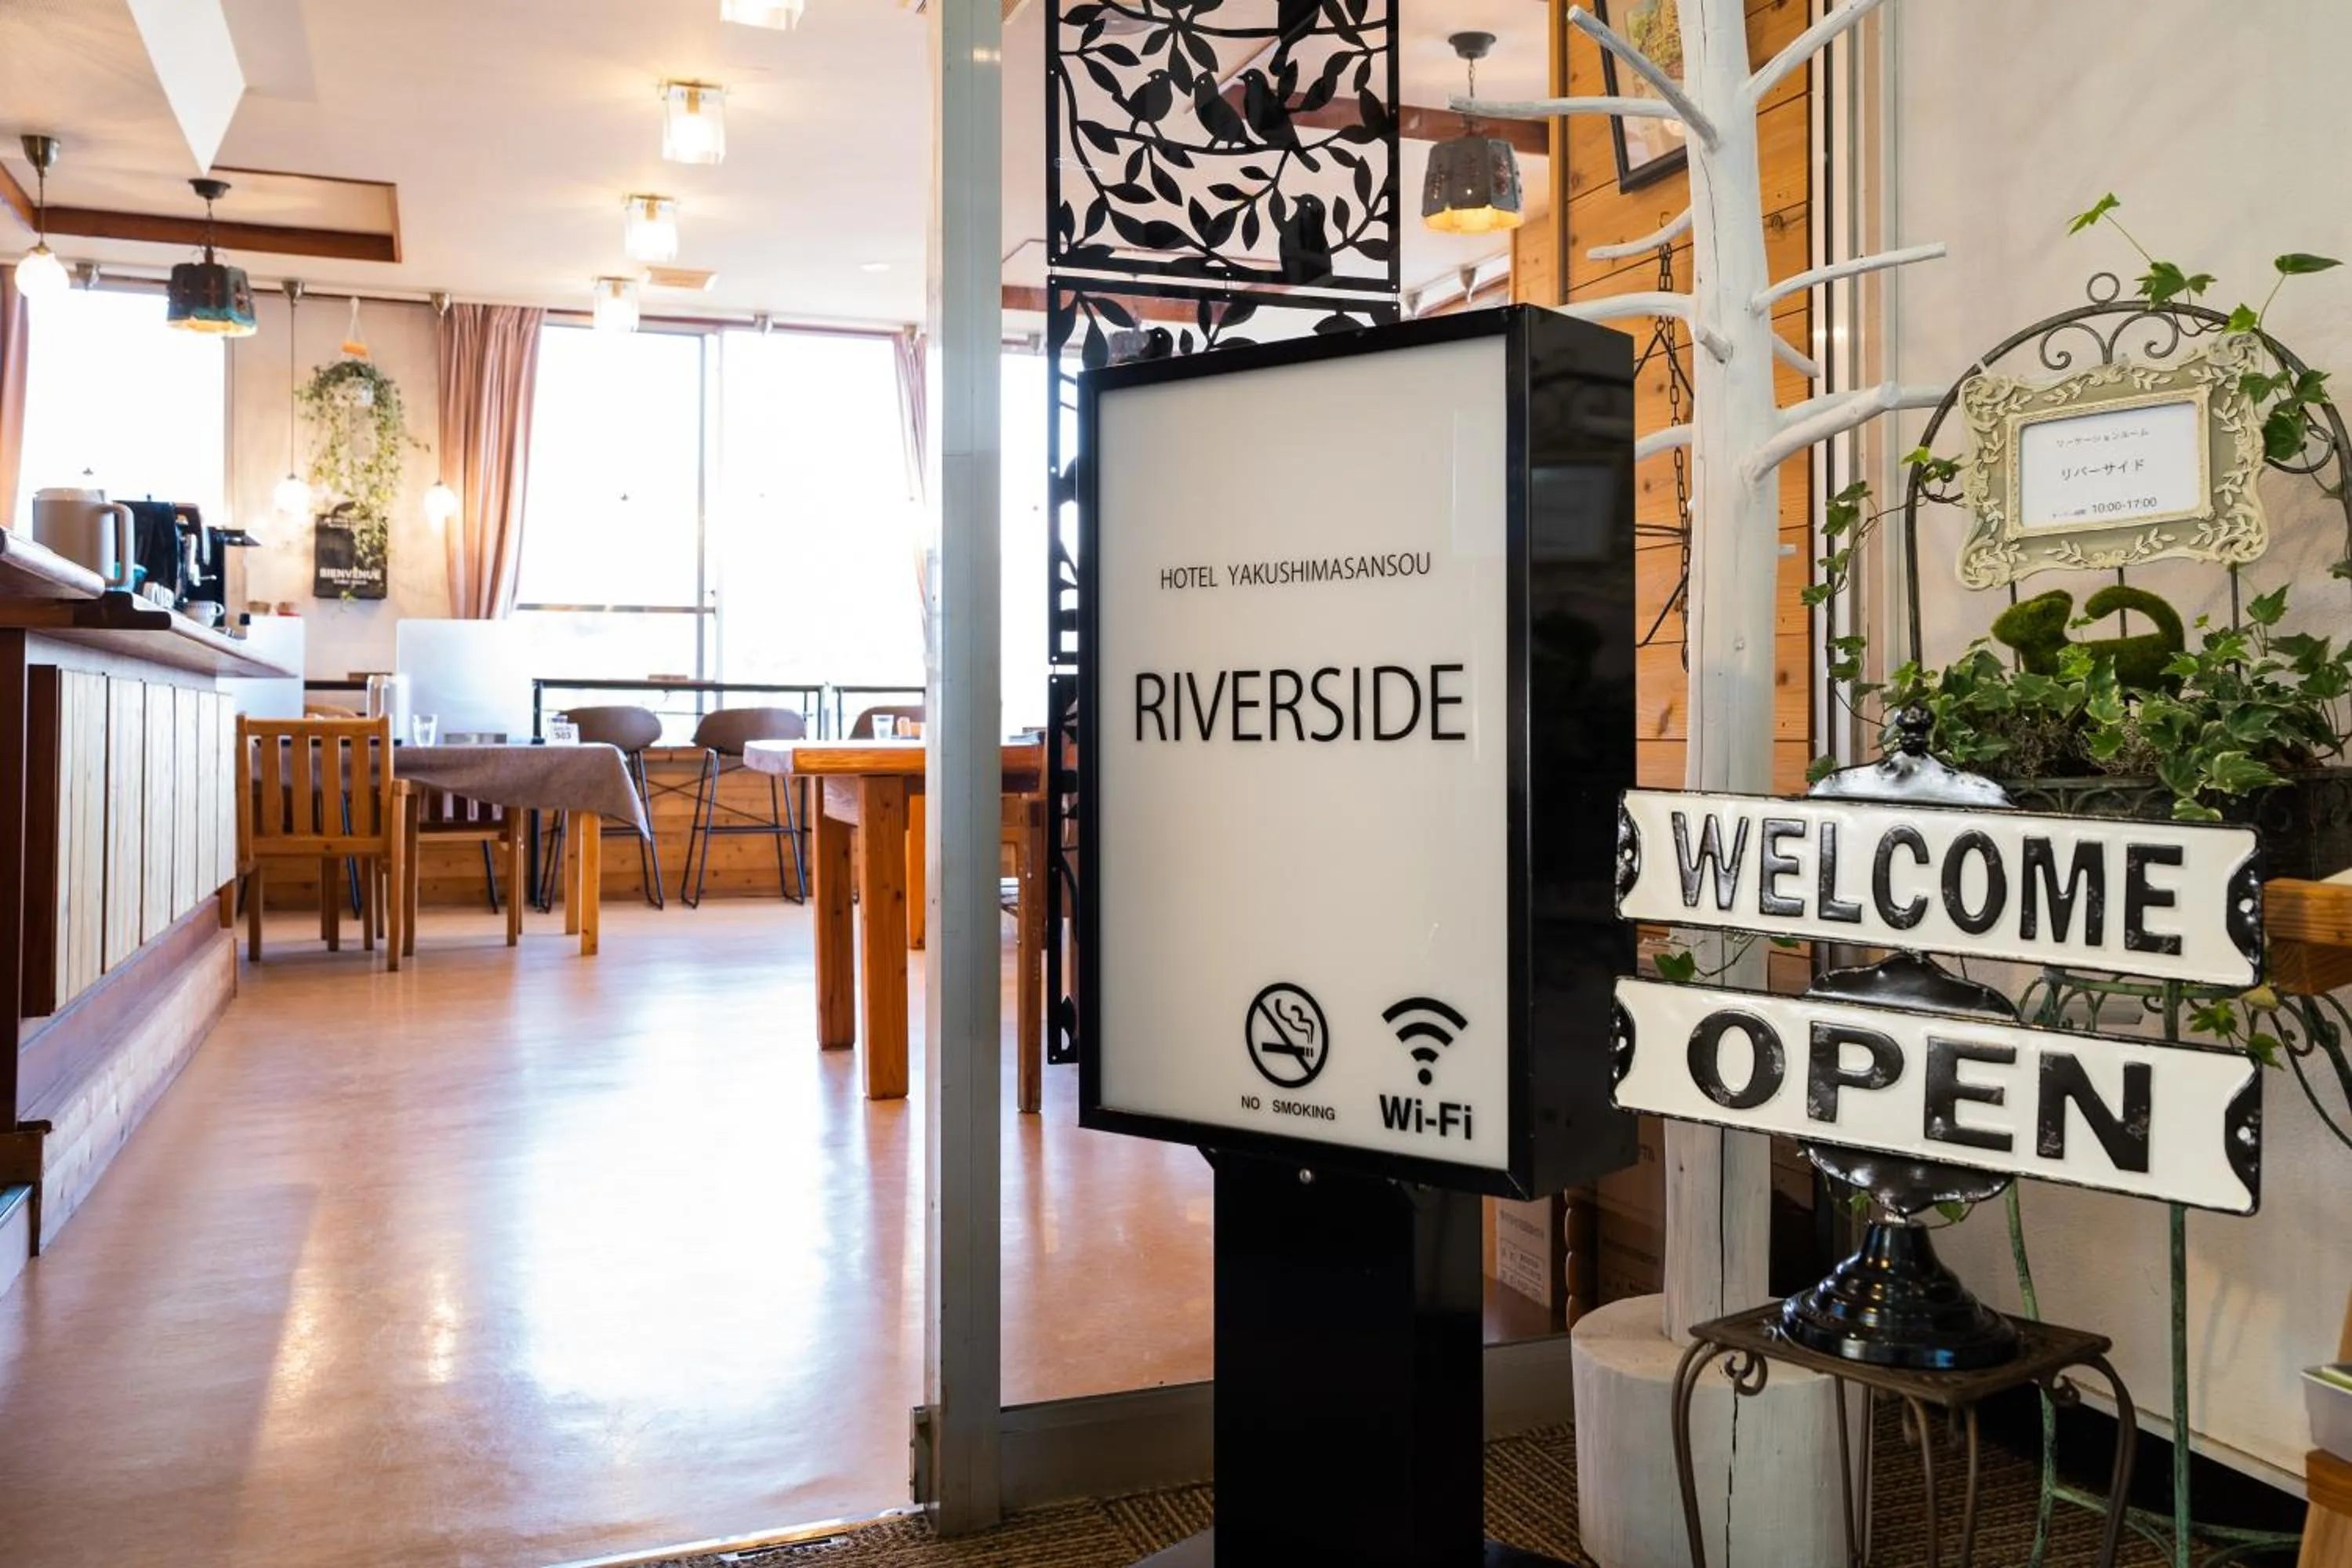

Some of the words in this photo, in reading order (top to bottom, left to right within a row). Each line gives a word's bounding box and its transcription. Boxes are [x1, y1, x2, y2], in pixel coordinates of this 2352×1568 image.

[2061, 458, 2145, 481] リバーサイド
[1160, 566, 1218, 590] HOTEL
[1228, 552, 1432, 586] YAKUSHIMASANSOU
[1136, 664, 1465, 742] RIVERSIDE
[1671, 811, 2183, 956] WELCOME
[1241, 1095, 1260, 1110] NO
[1272, 1099, 1336, 1121] SMOKING
[1686, 1009, 2152, 1173] OPEN
[1379, 1094, 1472, 1141] Wi-Fi
